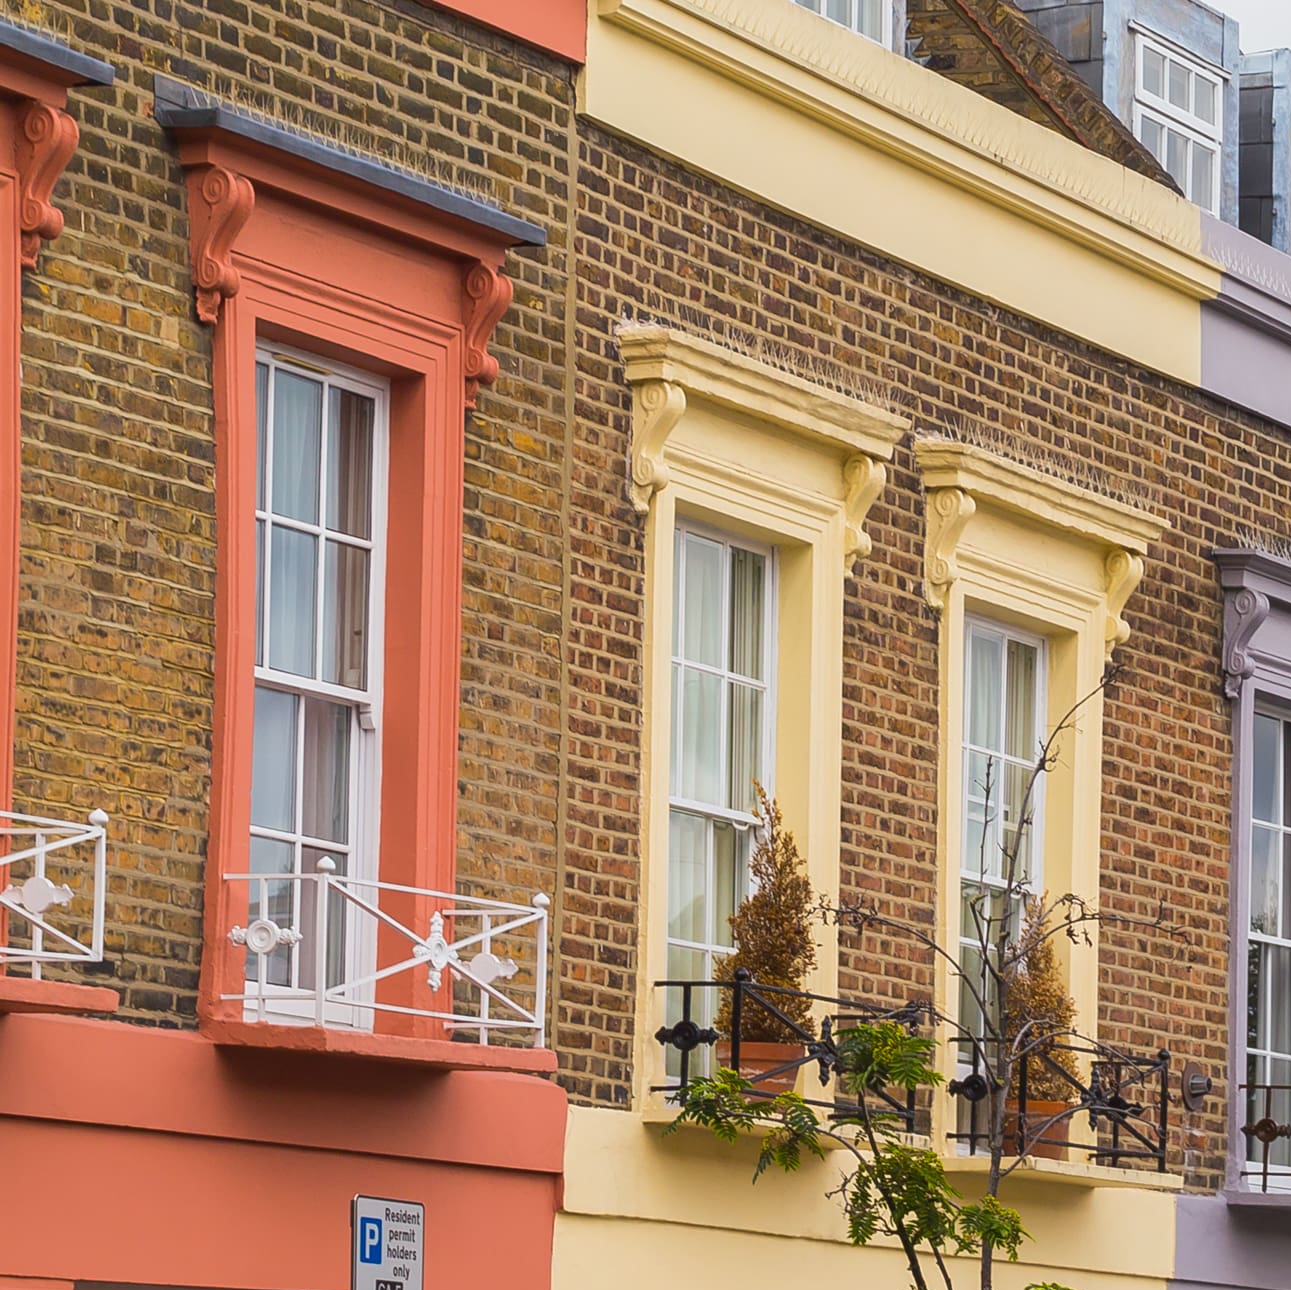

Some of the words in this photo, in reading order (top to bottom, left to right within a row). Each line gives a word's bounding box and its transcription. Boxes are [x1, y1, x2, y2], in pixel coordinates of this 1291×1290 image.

[385, 1207, 420, 1225] Resident
[365, 1222, 379, 1259] P
[388, 1228, 415, 1243] permit
[386, 1244, 417, 1261] holders
[393, 1264, 410, 1281] only
